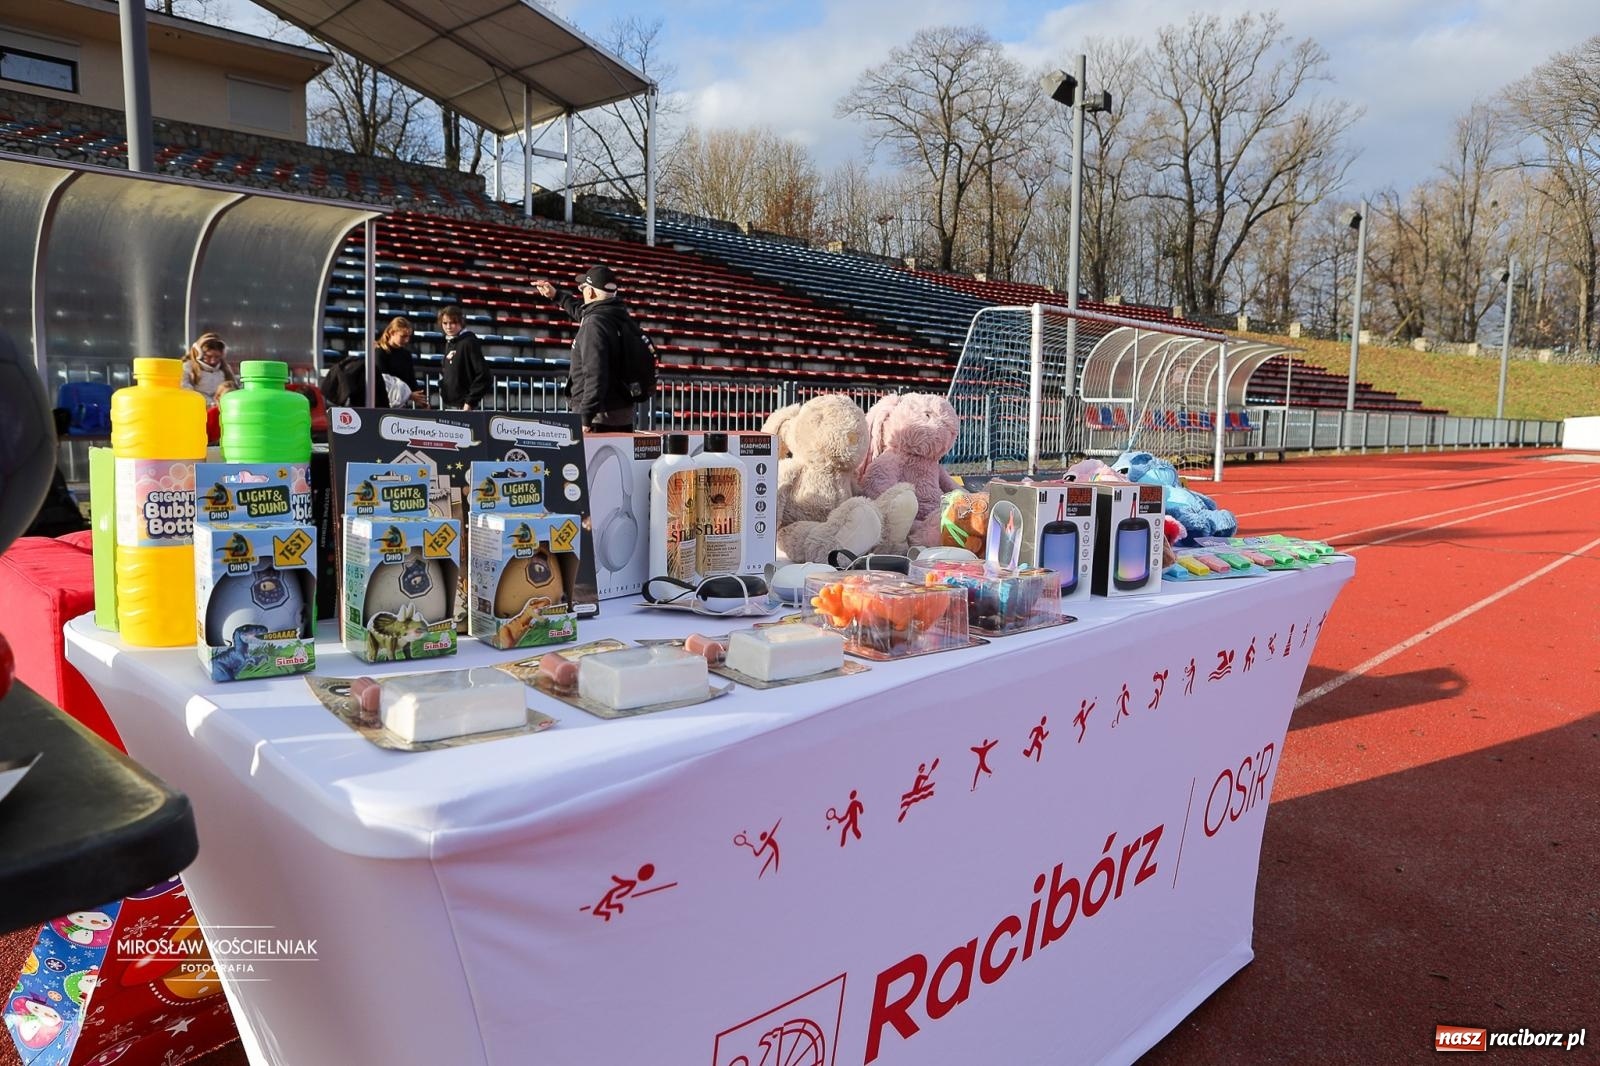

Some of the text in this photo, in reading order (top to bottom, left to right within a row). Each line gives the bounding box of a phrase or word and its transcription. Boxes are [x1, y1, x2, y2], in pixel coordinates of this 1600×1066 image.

[391, 422, 437, 437] Christmas
[439, 430, 464, 439] house
[497, 423, 536, 437] Christmas
[538, 429, 567, 439] lantern
[149, 491, 195, 503] GIGANT
[392, 498, 426, 511] SOUND
[511, 493, 540, 505] SOUND
[145, 502, 195, 519] Bubb
[210, 511, 228, 519] DINO
[250, 500, 288, 515] SOUND
[358, 506, 373, 514] DINO
[149, 518, 194, 535] Bott
[555, 522, 577, 546] TEST
[696, 518, 732, 535] snail
[279, 533, 306, 560] TEST
[427, 527, 451, 553] TEST
[276, 657, 305, 666] Simba
[864, 742, 1274, 1066] Racibórz OSiR
